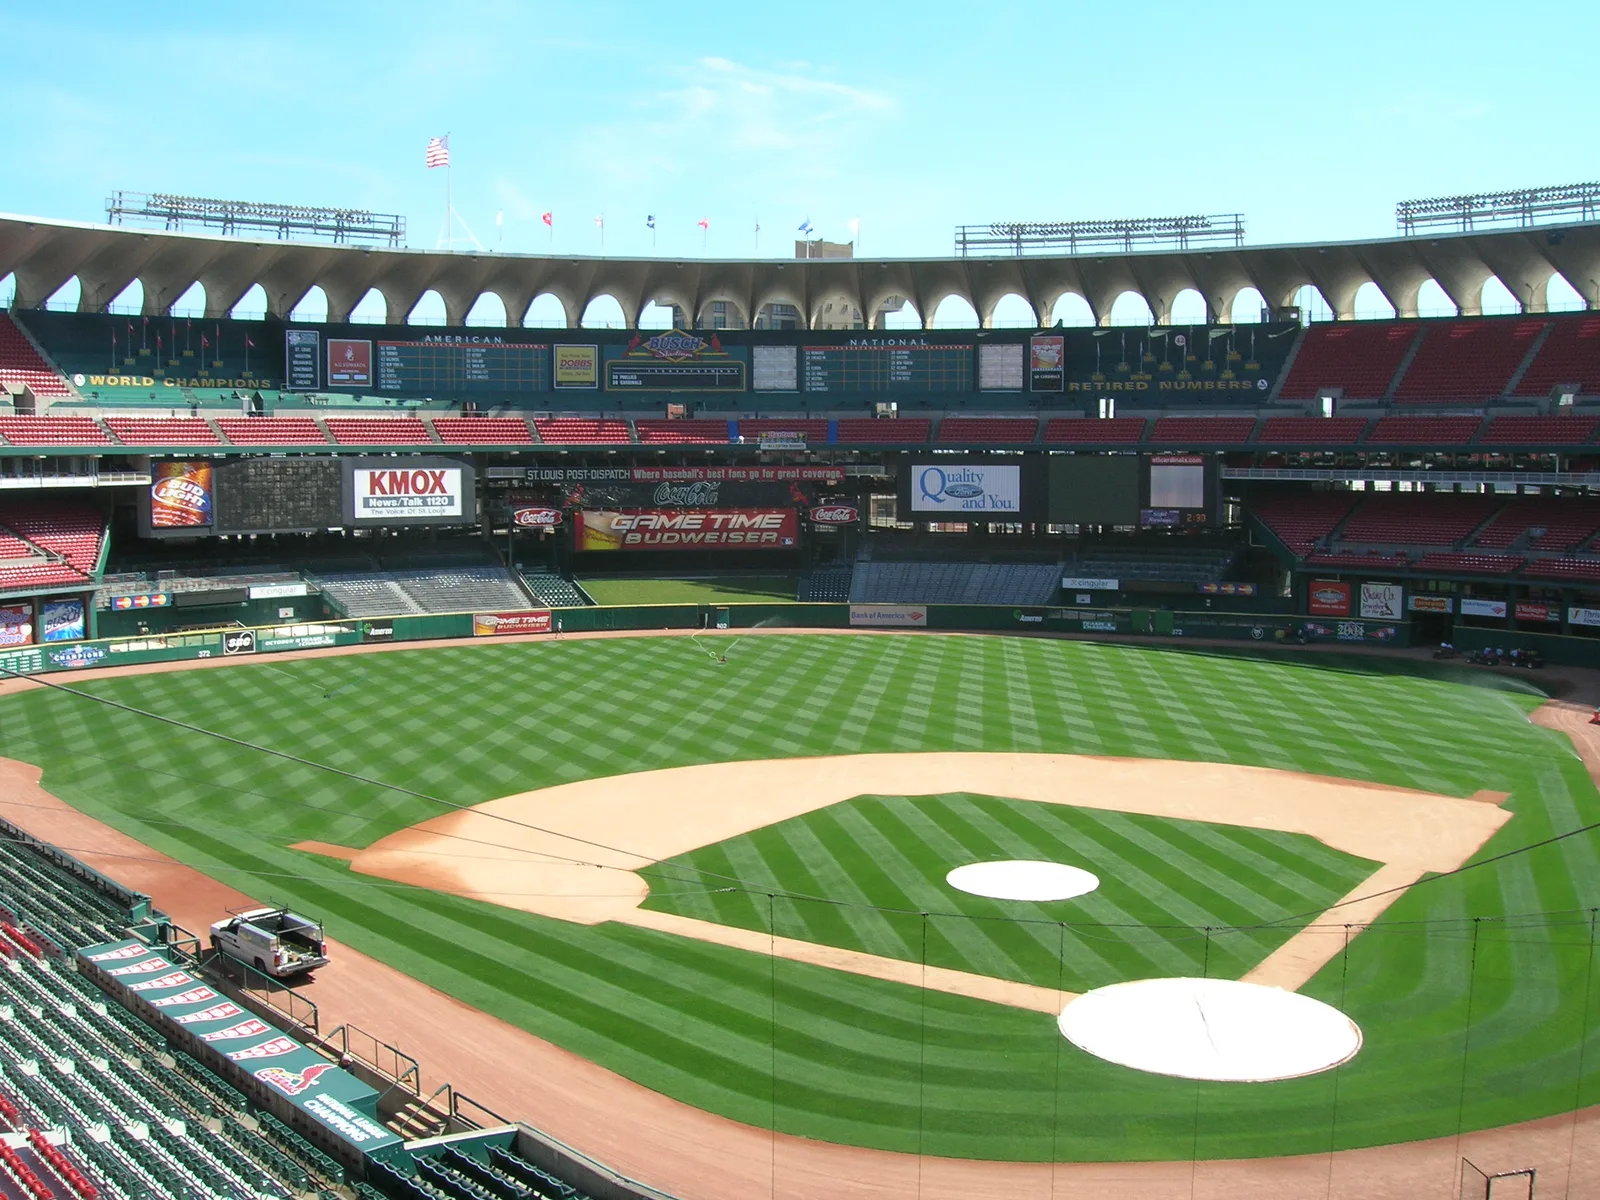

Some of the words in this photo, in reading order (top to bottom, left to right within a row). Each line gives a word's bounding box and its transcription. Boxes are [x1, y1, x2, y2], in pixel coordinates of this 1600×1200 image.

[424, 335, 502, 344] AMERICAN
[650, 336, 703, 350] BUSCH
[90, 376, 154, 387] WORLD
[163, 377, 271, 388] CHAMPIONS
[1068, 382, 1148, 391] RETIRED
[1159, 380, 1252, 390] NUMBERS
[527, 470, 540, 480] ST.
[541, 470, 564, 480] LOUIS
[567, 469, 630, 480] POST-DISPATCH
[634, 469, 660, 479] Where
[662, 469, 703, 478] baseball's
[707, 469, 725, 478] best
[728, 469, 746, 478] fans
[750, 470, 760, 480] go
[762, 469, 774, 478] for
[778, 469, 799, 480] great
[802, 469, 843, 479] coverage.
[168, 479, 204, 496] BUD
[369, 470, 448, 495] KMOX
[920, 467, 984, 503] Quality
[159, 488, 206, 506] LIGHT
[369, 497, 423, 506] News/Talk
[426, 496, 448, 506] 1120
[962, 495, 985, 508] and
[988, 494, 1014, 508] You.
[610, 514, 707, 530] GAME
[709, 514, 785, 529] TIME
[1186, 514, 1206, 522] 2:30
[625, 532, 778, 544] BUDWEISER
[266, 586, 296, 596] cingular
[45, 608, 81, 630] BUSCH
[486, 616, 520, 625] GAME
[228, 636, 251, 647] SBC
[54, 650, 104, 661] CHAMPIONS
[303, 1100, 370, 1142] CHAMPIONS
